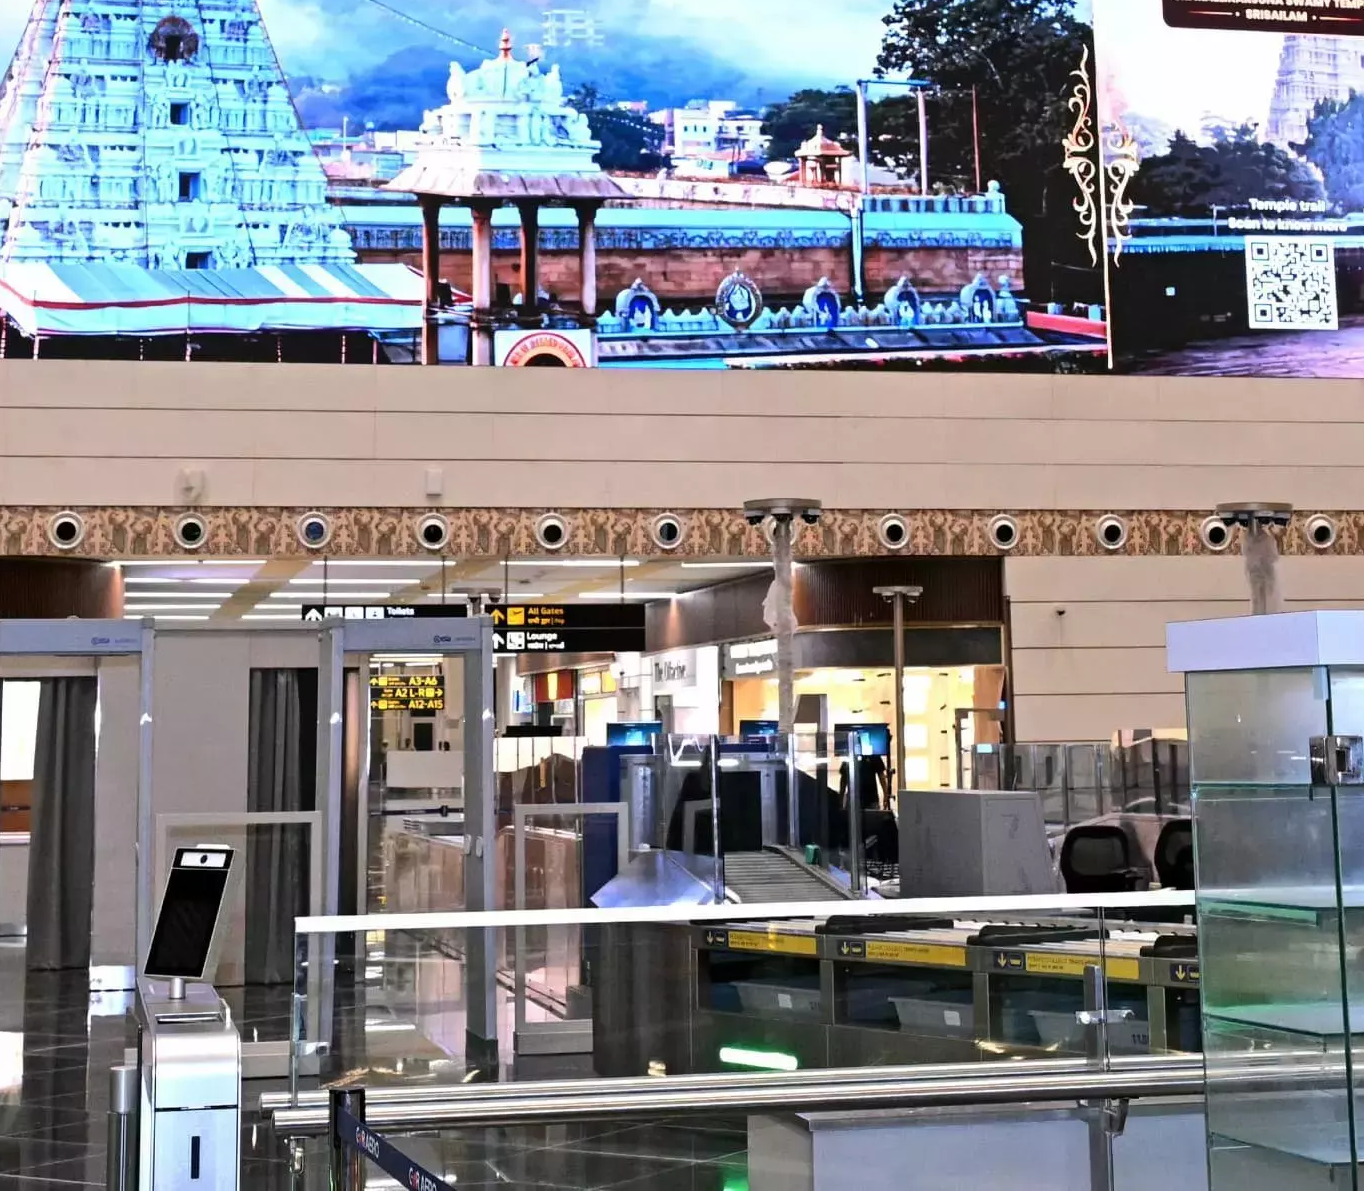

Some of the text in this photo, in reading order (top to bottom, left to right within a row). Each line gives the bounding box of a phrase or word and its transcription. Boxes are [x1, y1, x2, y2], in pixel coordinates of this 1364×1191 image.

[1246, 8, 1308, 22] SRISAILAM
[1248, 198, 1326, 213] Temple trail
[1227, 217, 1347, 232] Scan to know more
[386, 607, 415, 616] Toilets
[528, 607, 563, 615] All Gates
[526, 631, 557, 641] Lounge
[409, 676, 438, 686] A3-A6
[395, 688, 407, 697] A2
[408, 699, 443, 709] A12-A15
